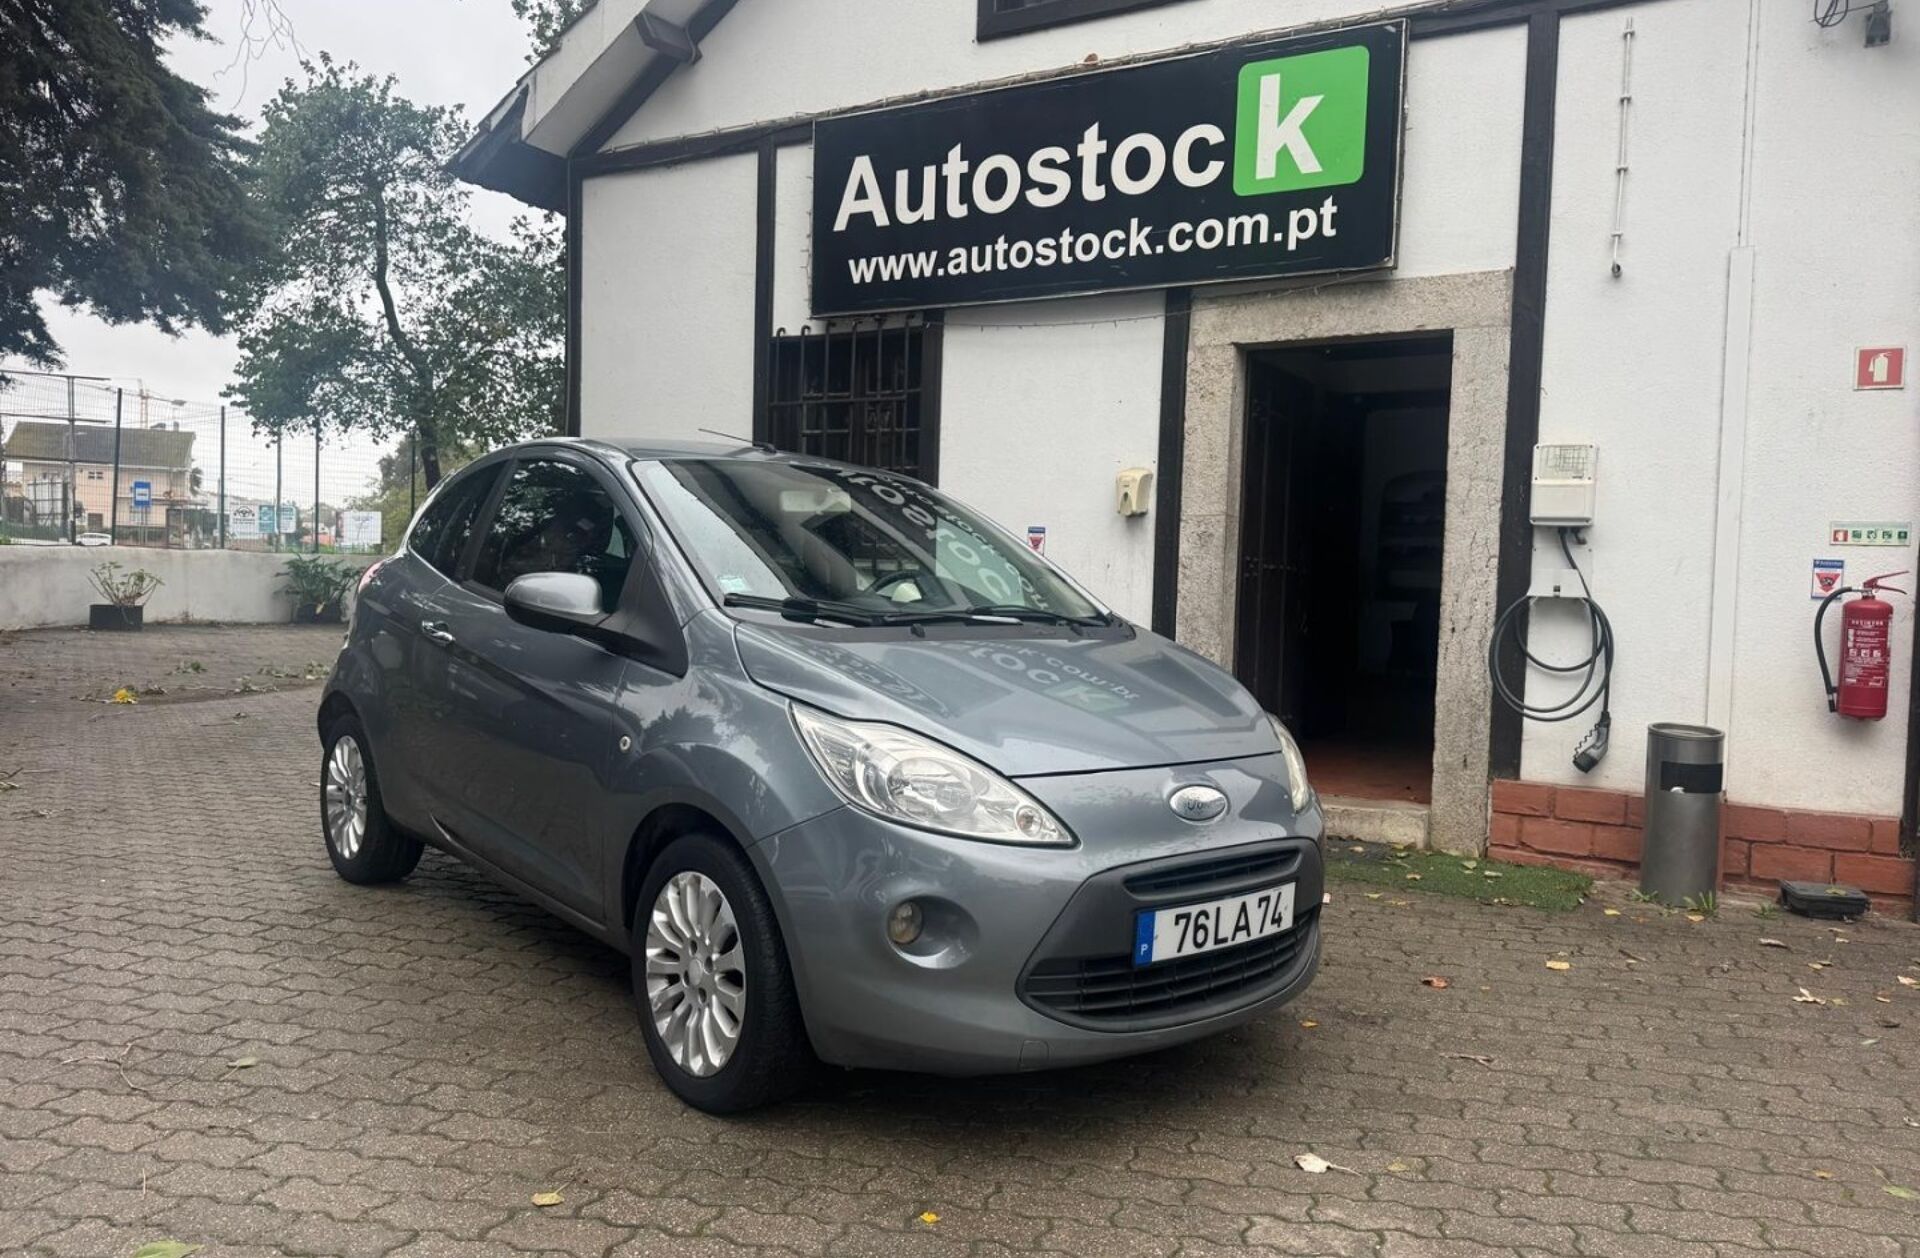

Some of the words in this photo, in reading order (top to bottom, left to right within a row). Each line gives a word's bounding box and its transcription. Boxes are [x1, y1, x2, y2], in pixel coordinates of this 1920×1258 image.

[832, 72, 1326, 232] Autostock
[848, 195, 1338, 284] www.autostock.com.pt
[1140, 943, 1148, 955] P
